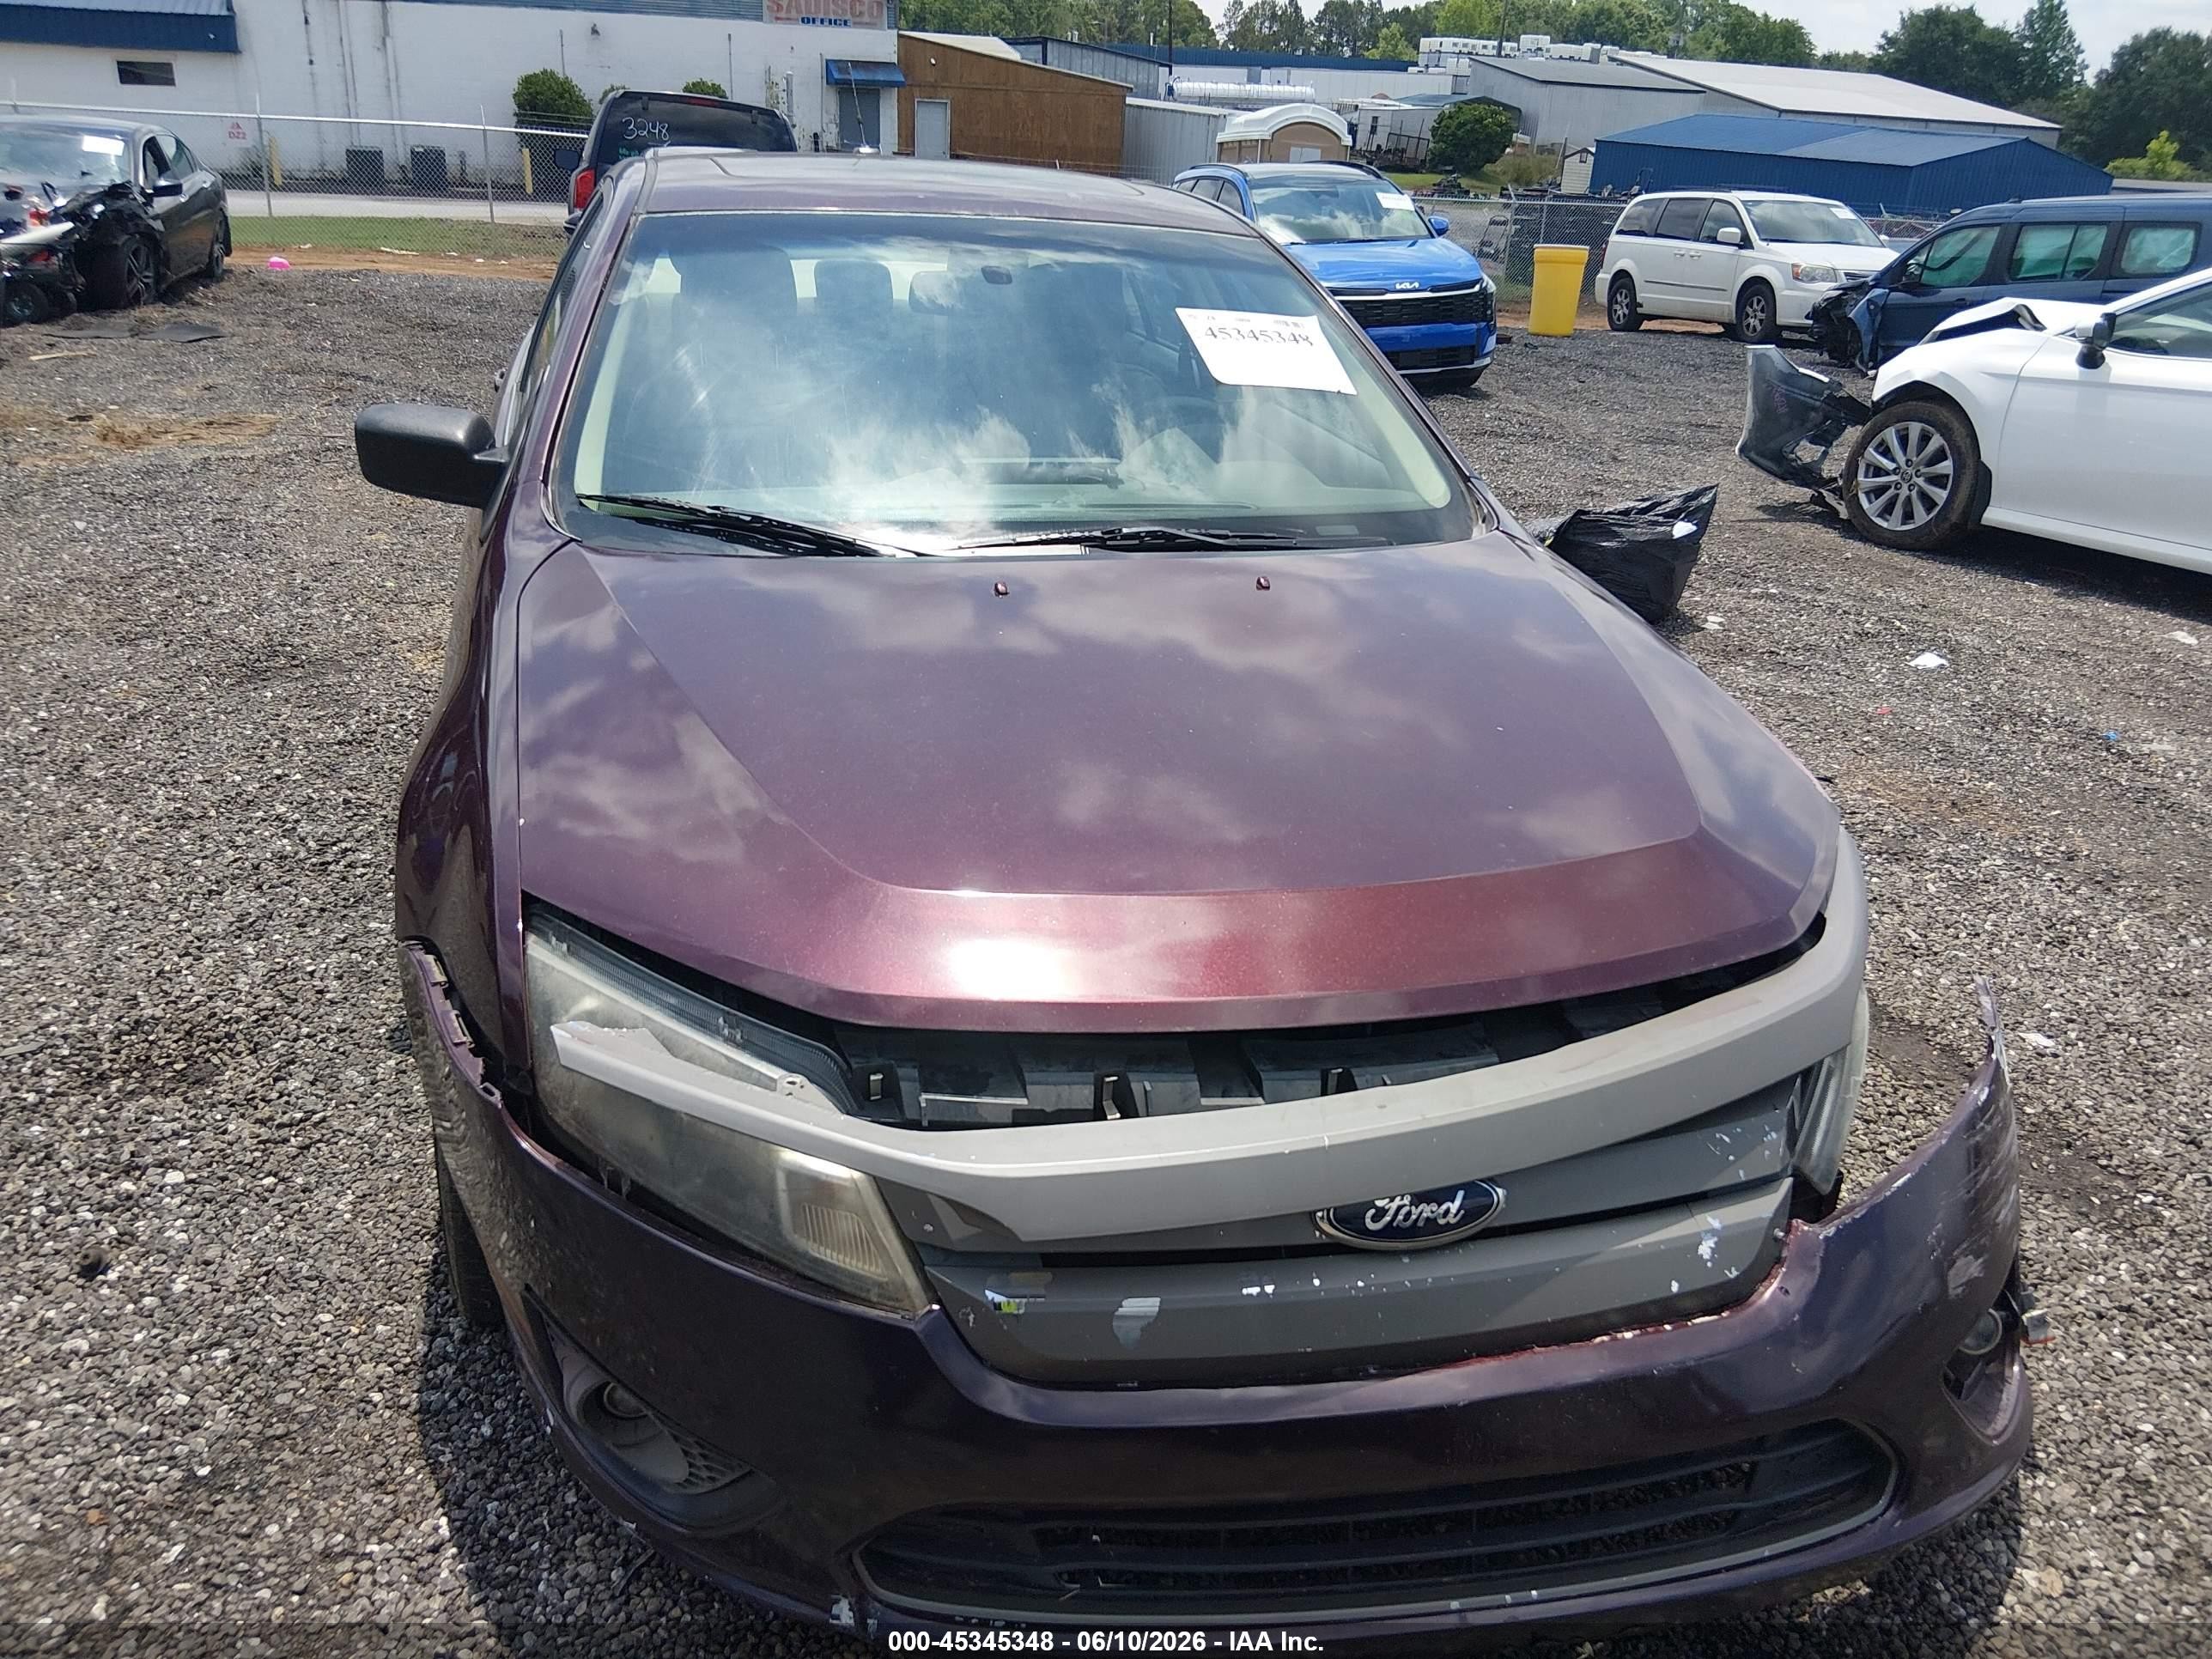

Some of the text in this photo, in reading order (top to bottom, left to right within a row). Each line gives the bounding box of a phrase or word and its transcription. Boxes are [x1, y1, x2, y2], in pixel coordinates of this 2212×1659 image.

[800, 16, 852, 27] OFFICE
[623, 117, 670, 141] 3248
[1204, 326, 1314, 346] 45345348
[1364, 1190, 1465, 1231] Ford
